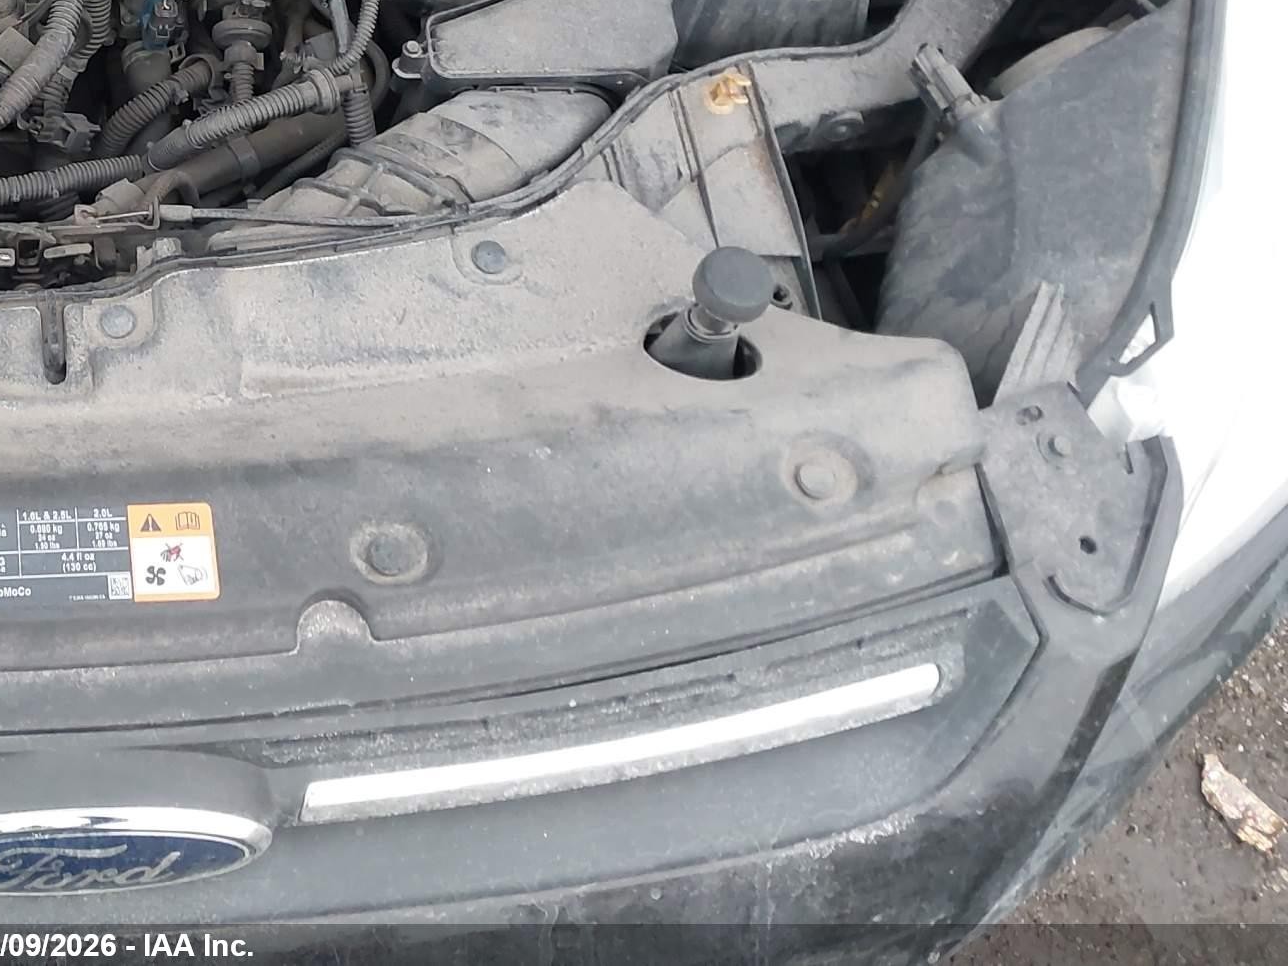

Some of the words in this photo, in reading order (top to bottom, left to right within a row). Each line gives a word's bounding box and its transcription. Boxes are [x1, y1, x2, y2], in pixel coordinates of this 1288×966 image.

[43, 511, 50, 519] &
[94, 509, 112, 518] 2.0L
[52, 524, 62, 535] kg
[110, 522, 120, 532] kg
[61, 553, 74, 561] 4.4
[85, 553, 95, 561] oz
[63, 563, 80, 573] (130
[83, 562, 96, 572] cc)
